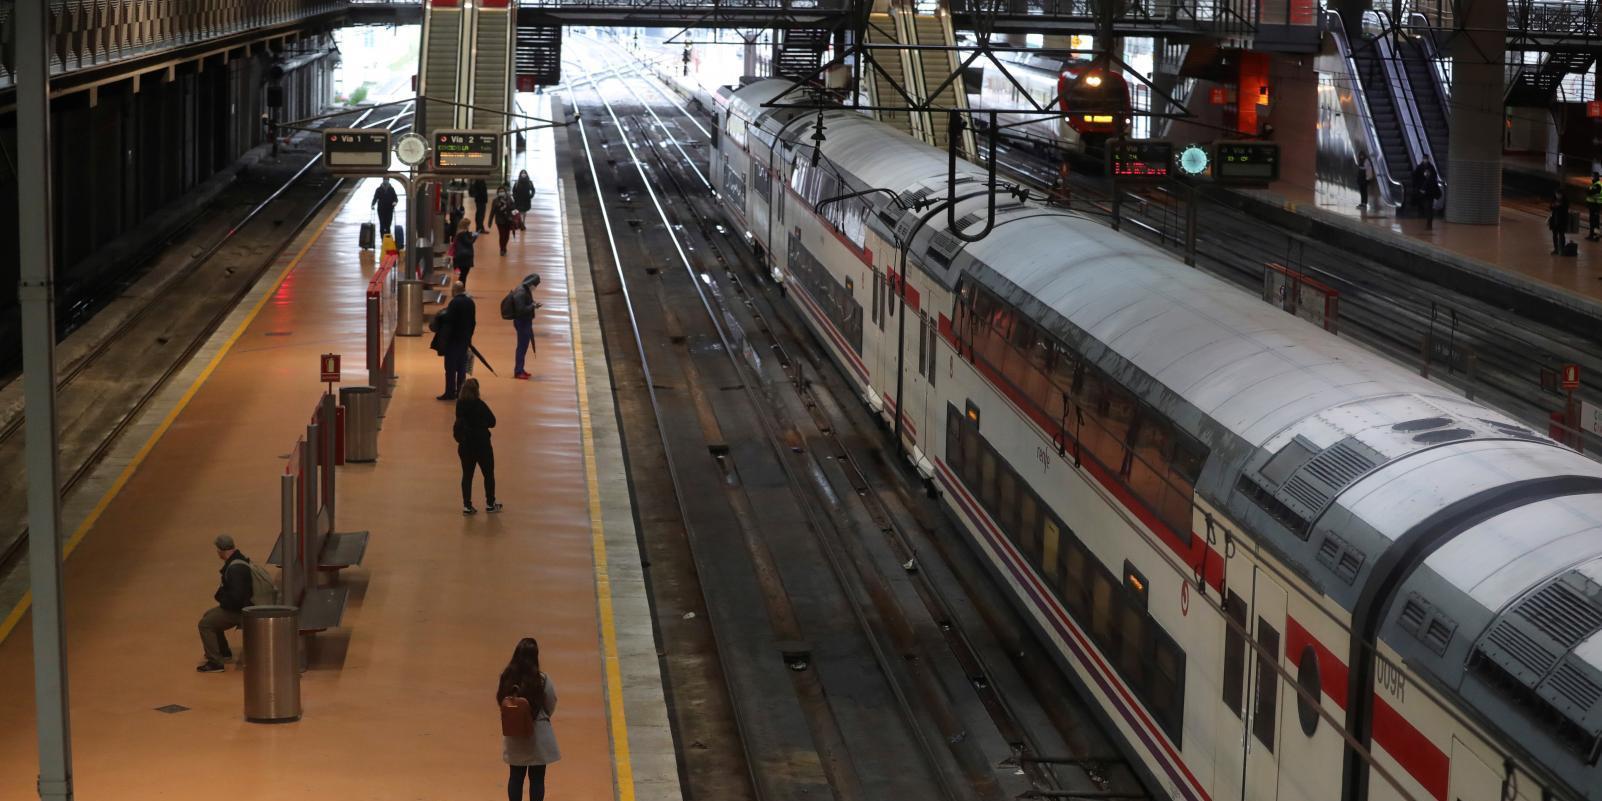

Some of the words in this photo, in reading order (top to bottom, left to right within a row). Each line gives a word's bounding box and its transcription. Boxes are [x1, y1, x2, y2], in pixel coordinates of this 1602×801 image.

[357, 135, 361, 143] 1
[468, 136, 474, 144] 2
[1036, 446, 1050, 473] renfe
